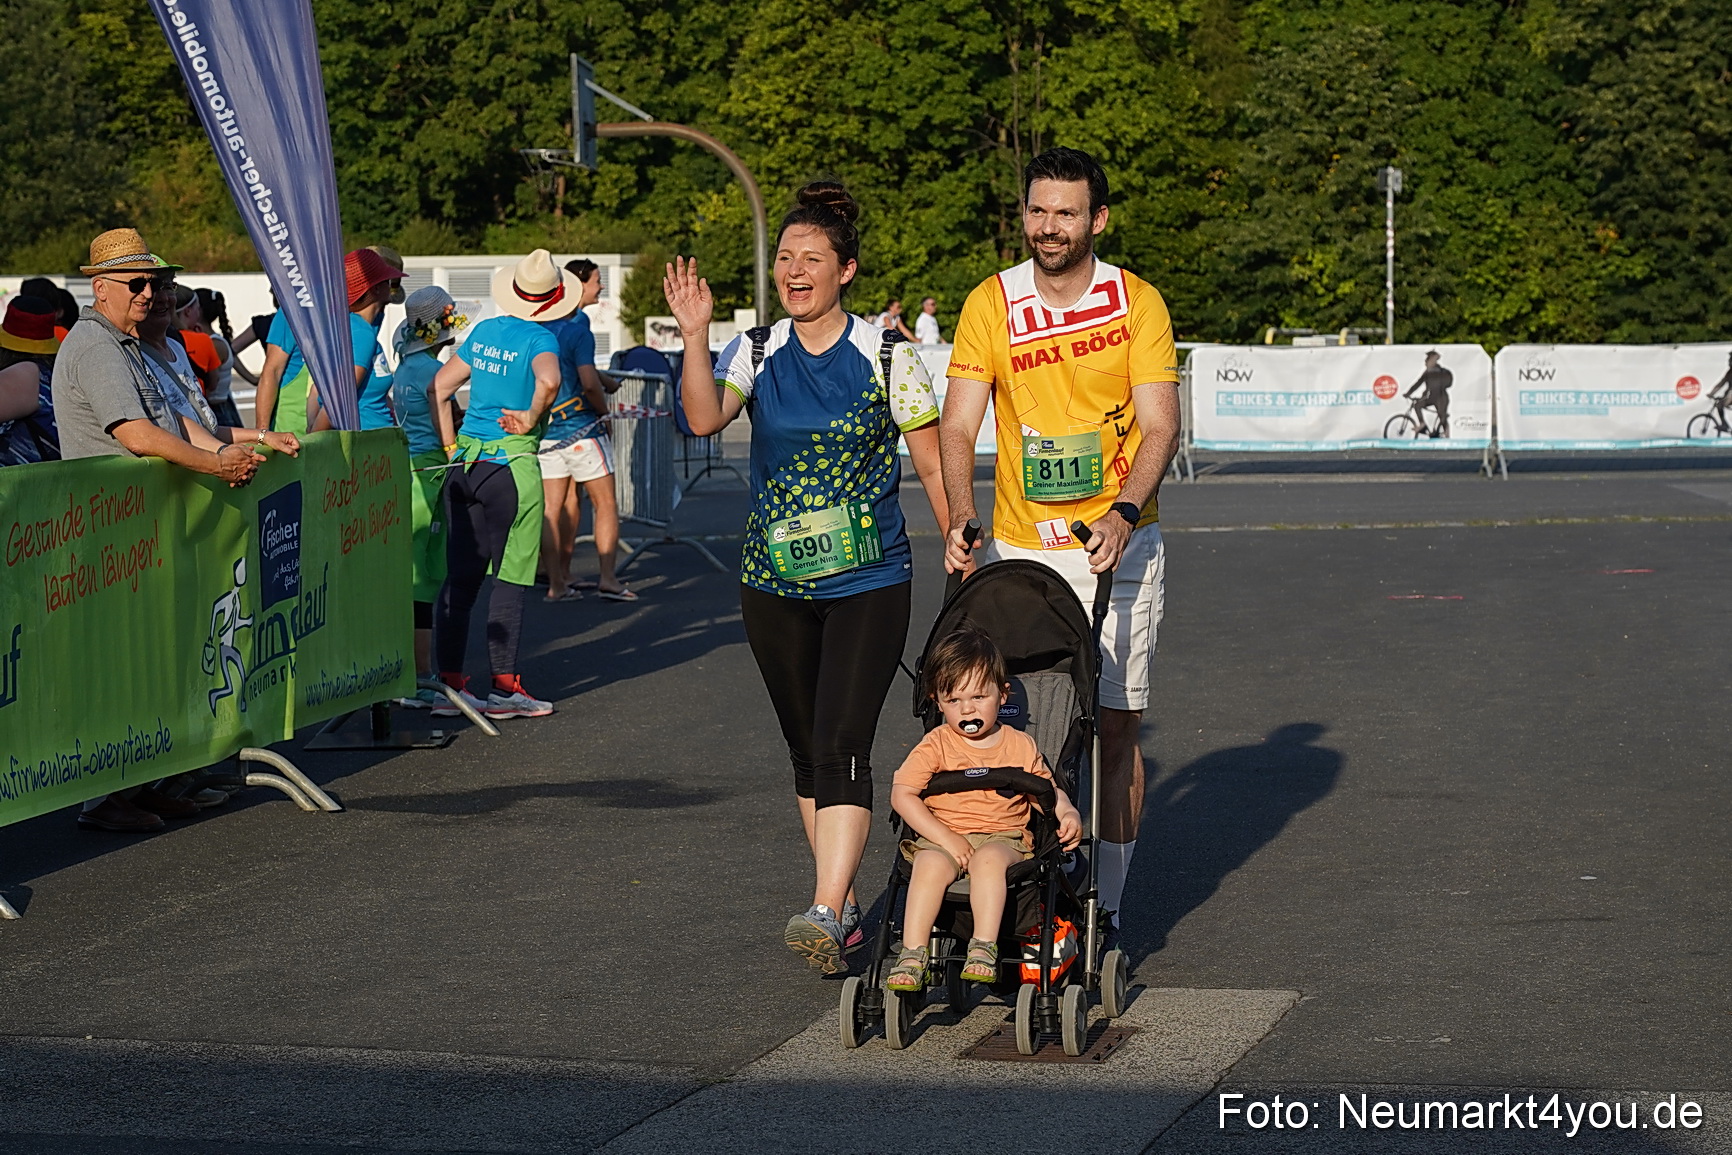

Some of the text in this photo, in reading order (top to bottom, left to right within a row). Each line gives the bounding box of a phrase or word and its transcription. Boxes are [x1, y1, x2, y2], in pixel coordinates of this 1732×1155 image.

[1011, 345, 1065, 373] MAX
[1216, 369, 1254, 382] NOW
[1519, 368, 1556, 381] NOW
[1218, 393, 1273, 405] E-BIKES
[1521, 392, 1576, 404] E-BIKES
[1026, 465, 1034, 488] RUN
[1039, 457, 1080, 480] 811
[1091, 457, 1100, 487] 2022
[1032, 478, 1093, 489] Greiner Maximilian
[6, 485, 145, 567] Gesunde Firmen
[266, 521, 299, 550] Fischer
[789, 532, 833, 560] 690
[840, 530, 854, 560] 2022
[44, 519, 162, 614] laufen länger!
[774, 550, 787, 572] RUN
[792, 559, 819, 570] Gerner
[819, 554, 839, 564] Nina
